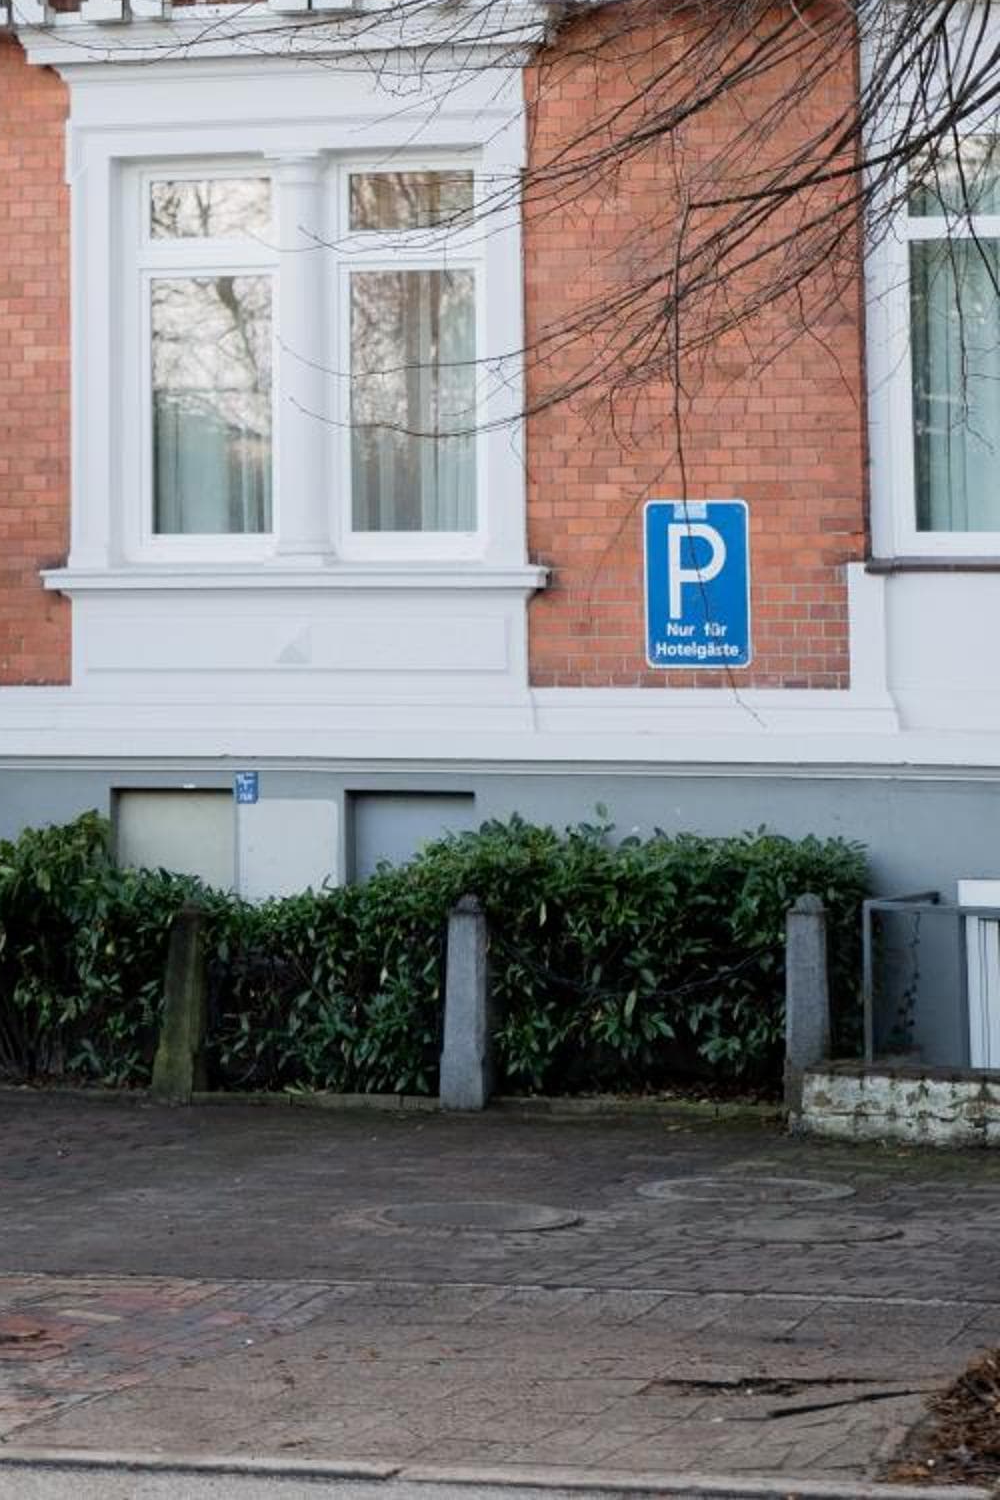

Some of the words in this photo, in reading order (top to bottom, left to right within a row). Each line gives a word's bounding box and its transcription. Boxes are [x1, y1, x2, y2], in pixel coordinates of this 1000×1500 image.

[668, 523, 727, 619] P
[666, 622, 695, 637] Nur
[703, 621, 728, 637] für
[655, 642, 740, 659] Hotelgäste
